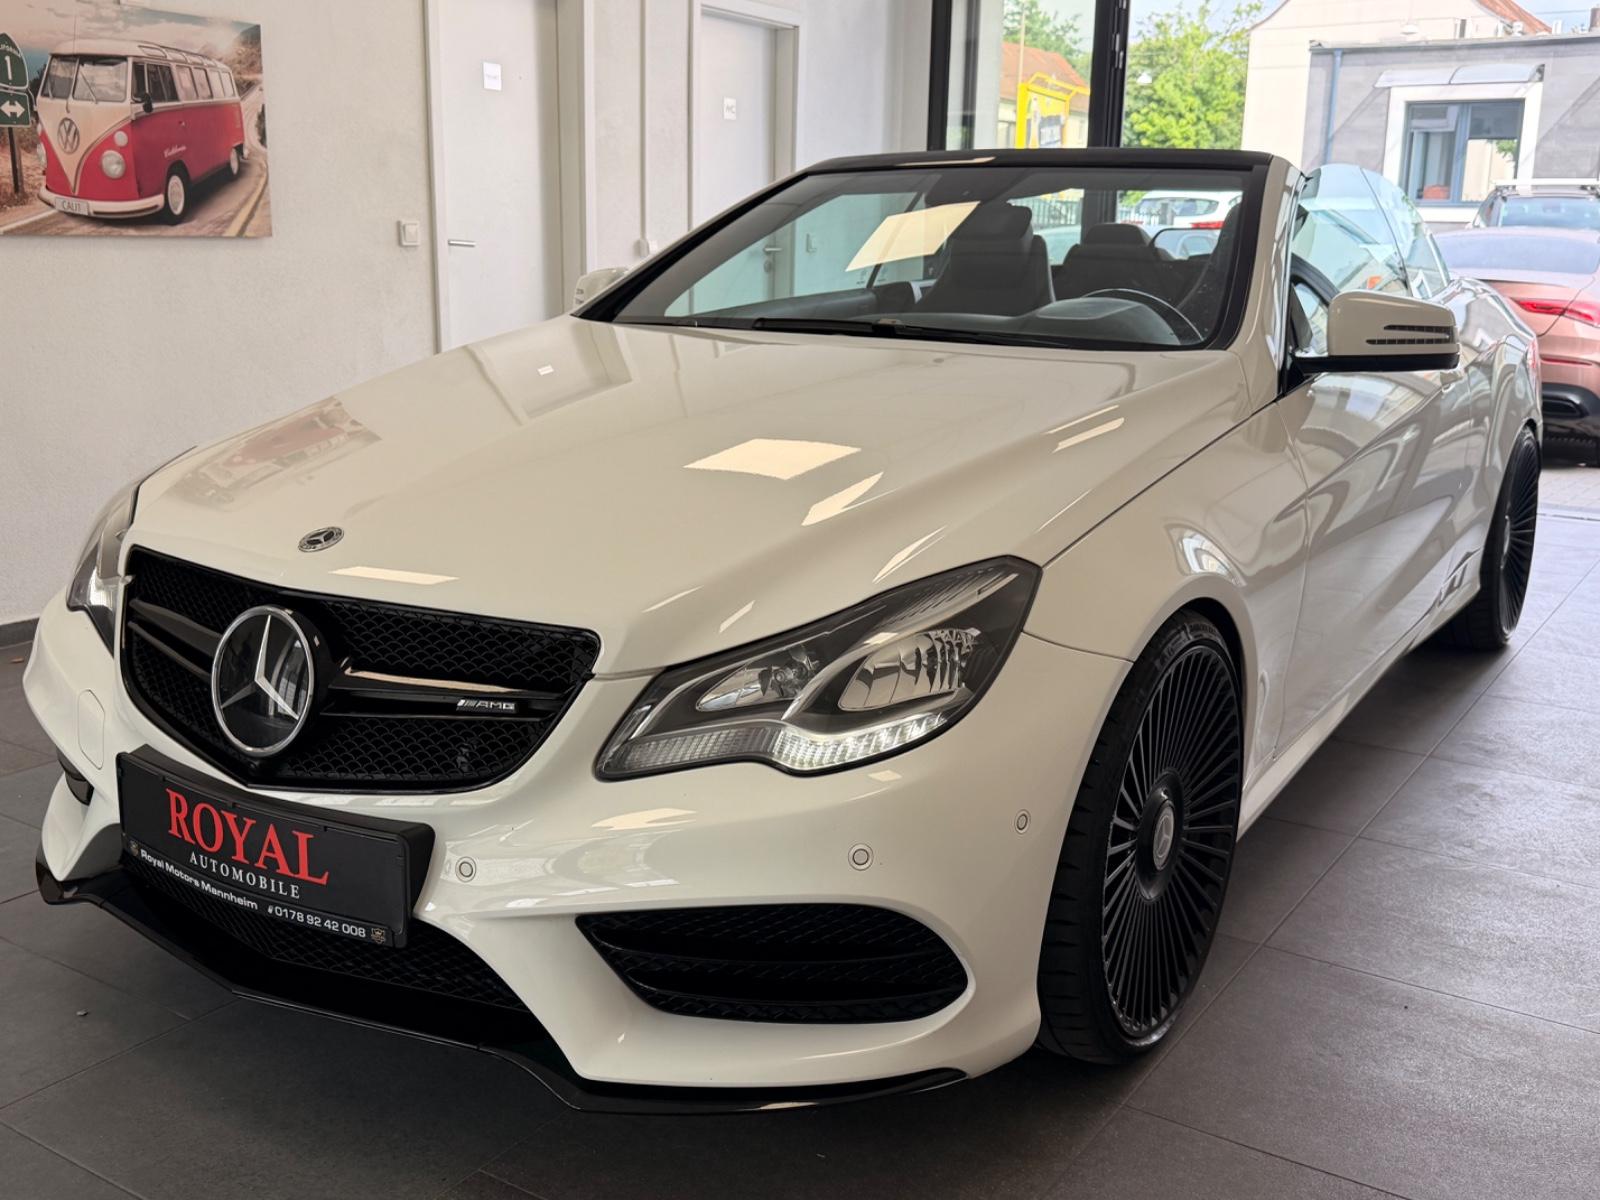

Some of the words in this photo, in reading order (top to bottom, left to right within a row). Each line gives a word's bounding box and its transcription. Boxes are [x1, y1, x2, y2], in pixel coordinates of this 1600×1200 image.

[475, 700, 515, 710] AMG
[166, 787, 329, 886] ROYAL
[140, 849, 165, 869] Royal
[165, 862, 200, 888] Motors
[201, 881, 258, 910] Mannheim
[274, 905, 305, 923] 0178
[306, 914, 321, 927] 92
[323, 919, 340, 932] 42
[341, 923, 366, 938] 008
[189, 851, 300, 899] AUTOMOBILE
